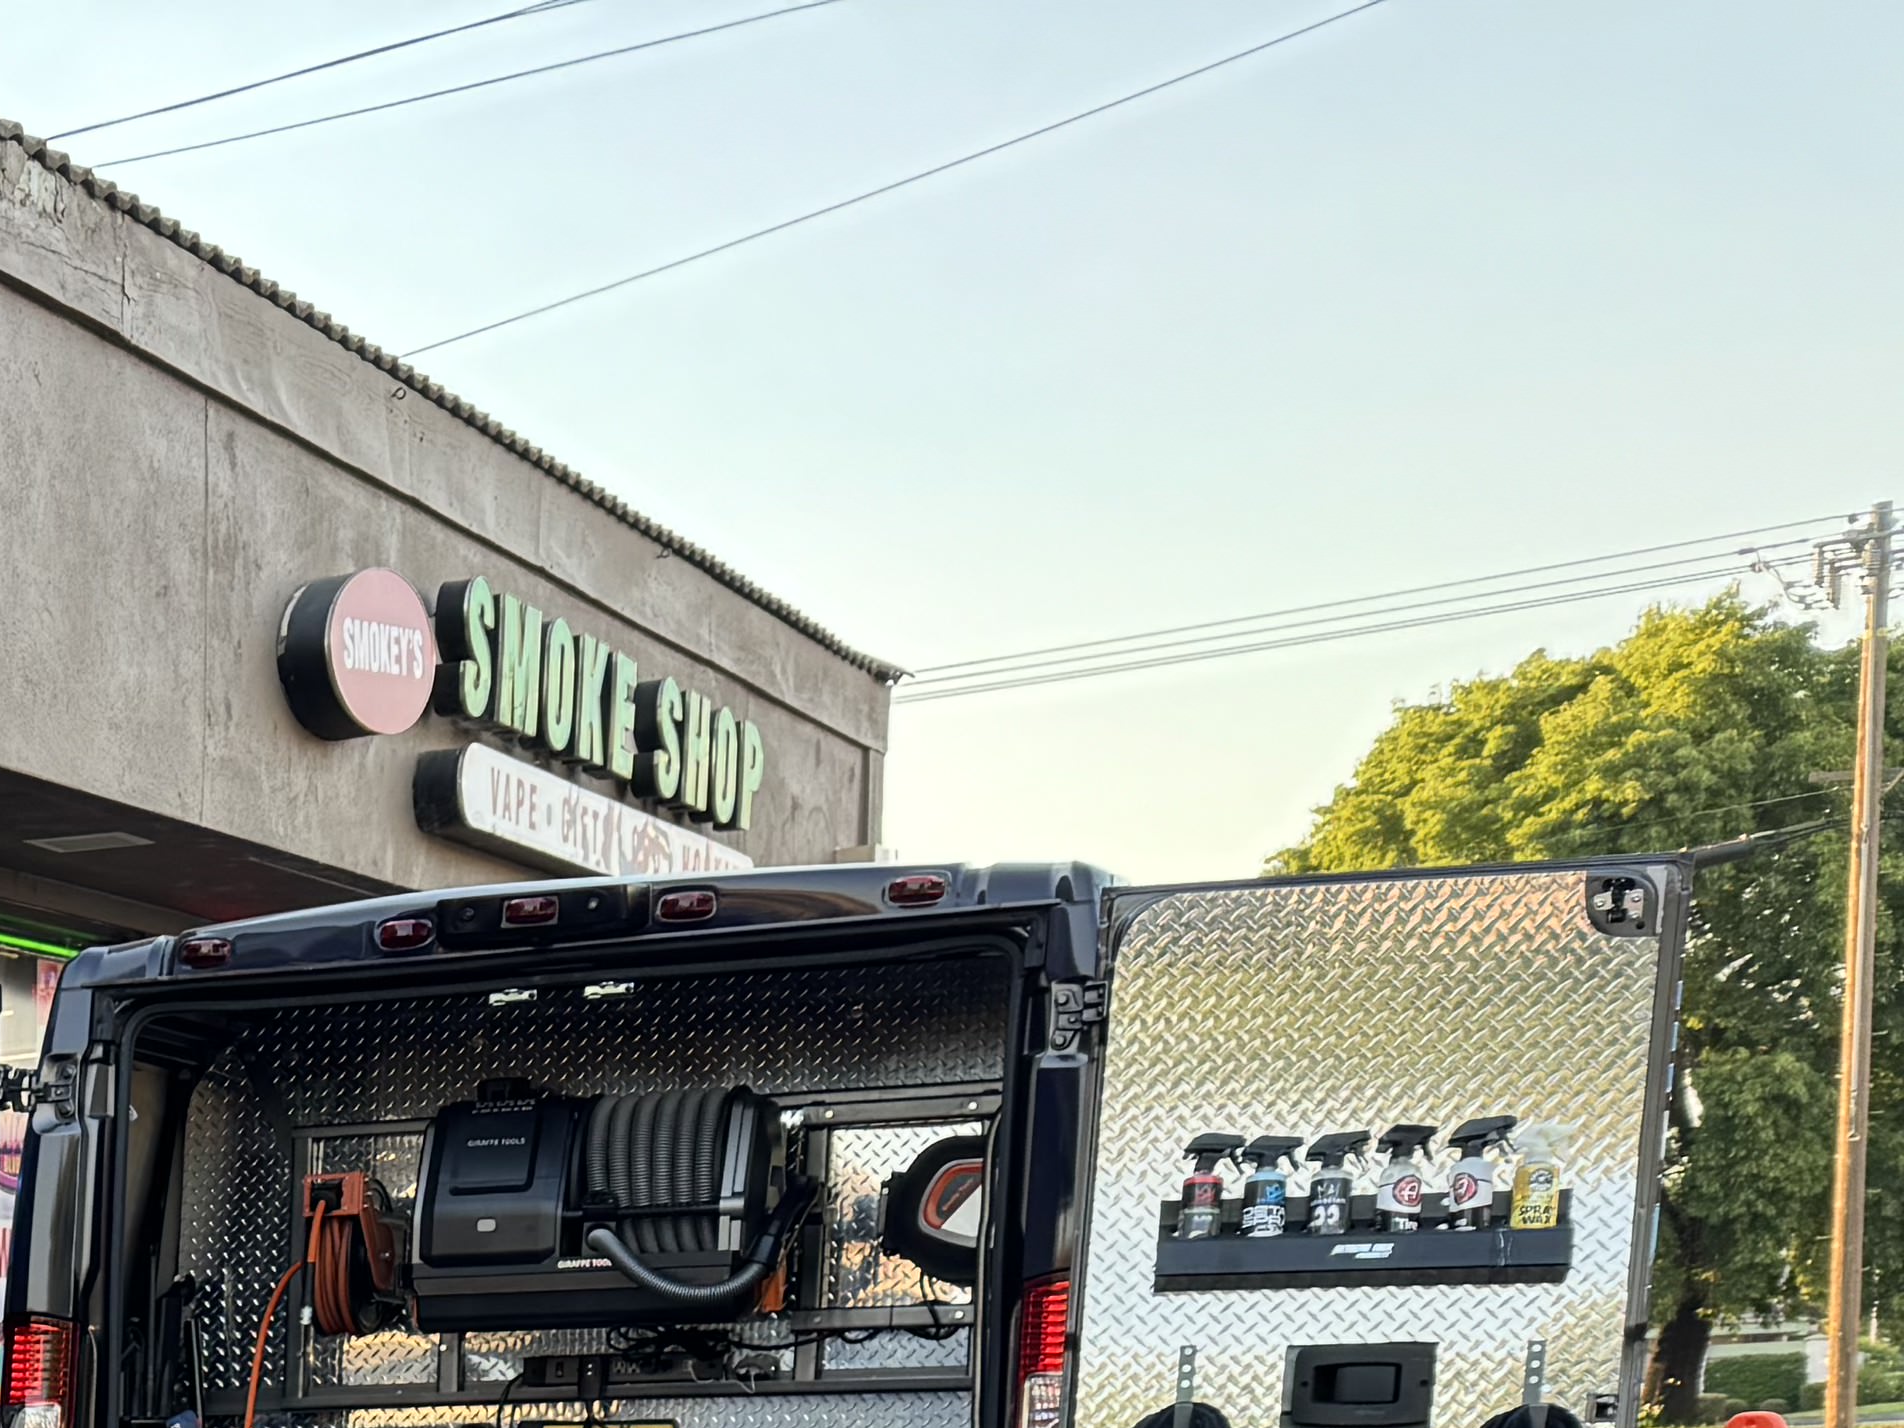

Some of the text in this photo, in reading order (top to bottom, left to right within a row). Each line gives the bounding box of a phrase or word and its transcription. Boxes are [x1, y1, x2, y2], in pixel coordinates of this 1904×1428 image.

[343, 616, 424, 680] SMOKEY'S
[458, 575, 765, 832] SMOKE SHOP
[490, 767, 538, 831] VAPE
[501, 1136, 526, 1146] TOOLS
